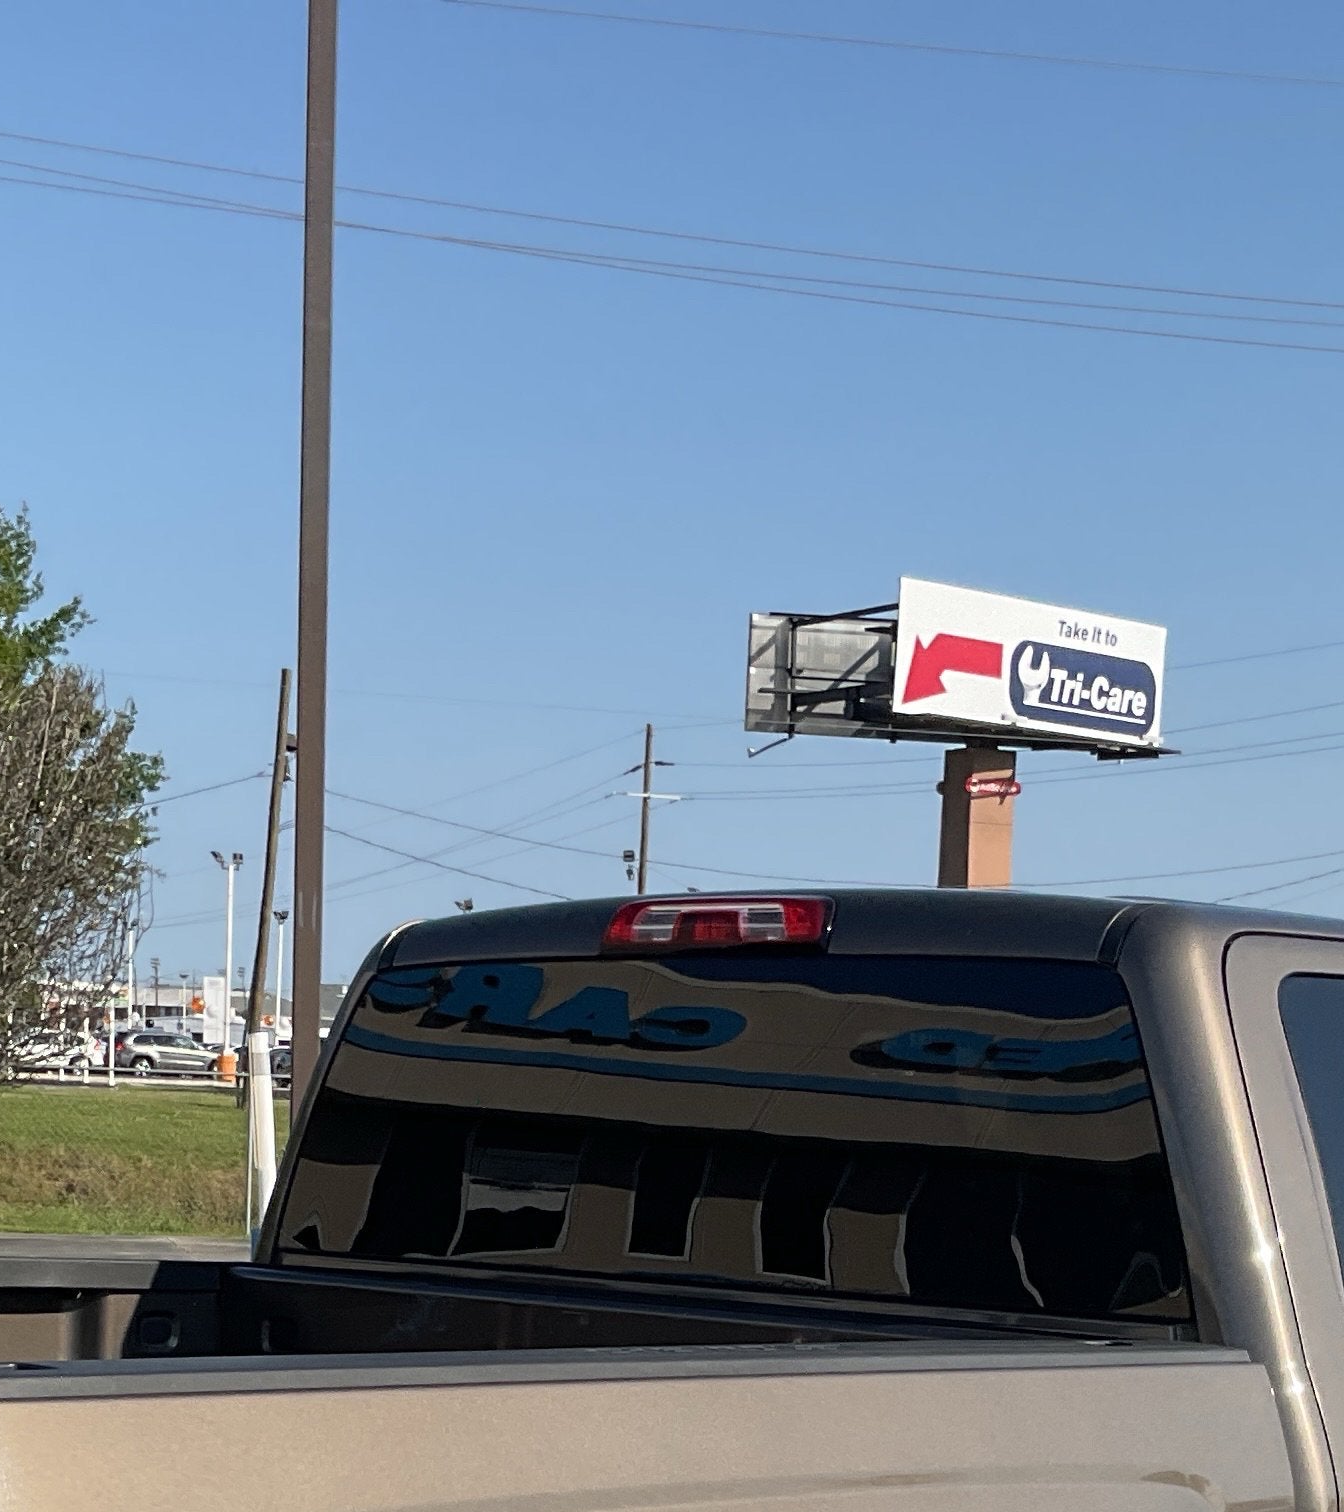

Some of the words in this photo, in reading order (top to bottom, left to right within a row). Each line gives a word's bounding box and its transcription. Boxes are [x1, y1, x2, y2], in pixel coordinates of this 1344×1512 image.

[1058, 620, 1089, 641] Take
[1104, 629, 1119, 647] to
[1050, 668, 1147, 717] Tri-Care
